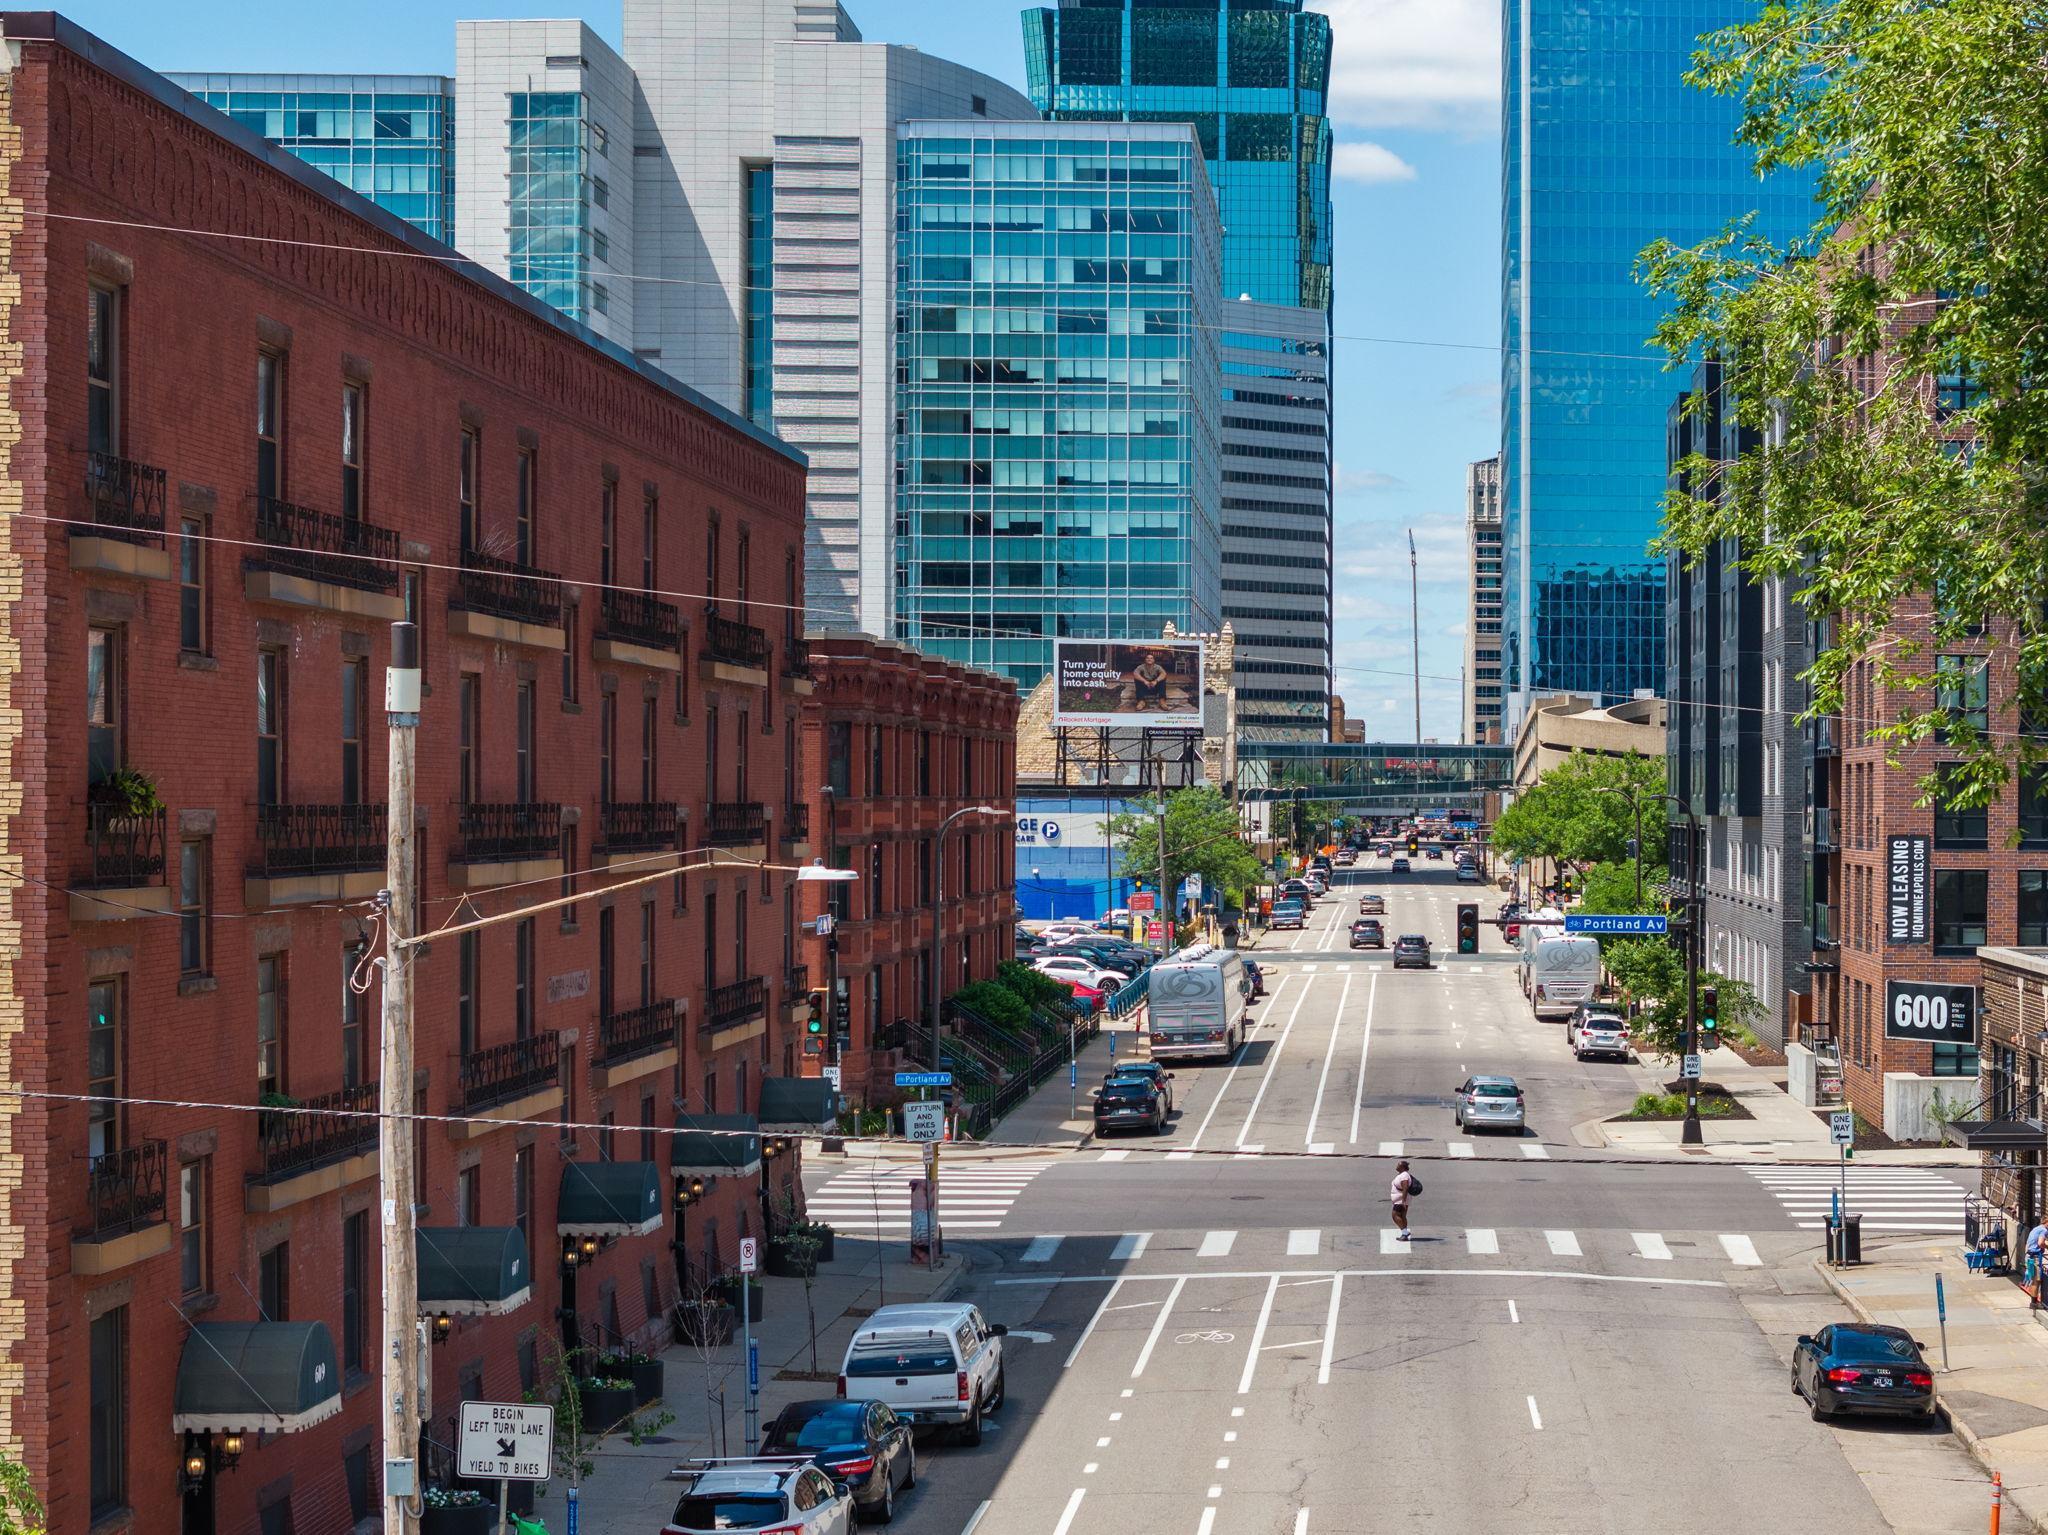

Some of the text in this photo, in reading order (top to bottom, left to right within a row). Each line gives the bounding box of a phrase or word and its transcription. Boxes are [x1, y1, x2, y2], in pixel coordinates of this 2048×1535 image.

[1063, 660, 1106, 670] Turn your
[1063, 670, 1121, 680] home equity
[1063, 678, 1107, 687] into cash.
[1018, 818, 1038, 831] GE
[1892, 840, 1909, 938] NOW LEASING
[1912, 840, 1925, 938] HQMINNEAPOLIS.COM
[1584, 919, 1663, 929] Portland Av
[1895, 994, 1948, 1030] 600
[914, 1130, 936, 1138] ONLY
[1834, 1124, 1850, 1132] WAY
[315, 1362, 326, 1384] 609
[493, 1408, 524, 1420] BEGIN
[470, 1422, 544, 1436] LEFT TURN LANE
[470, 1460, 538, 1474] YIELD TO BIKES
